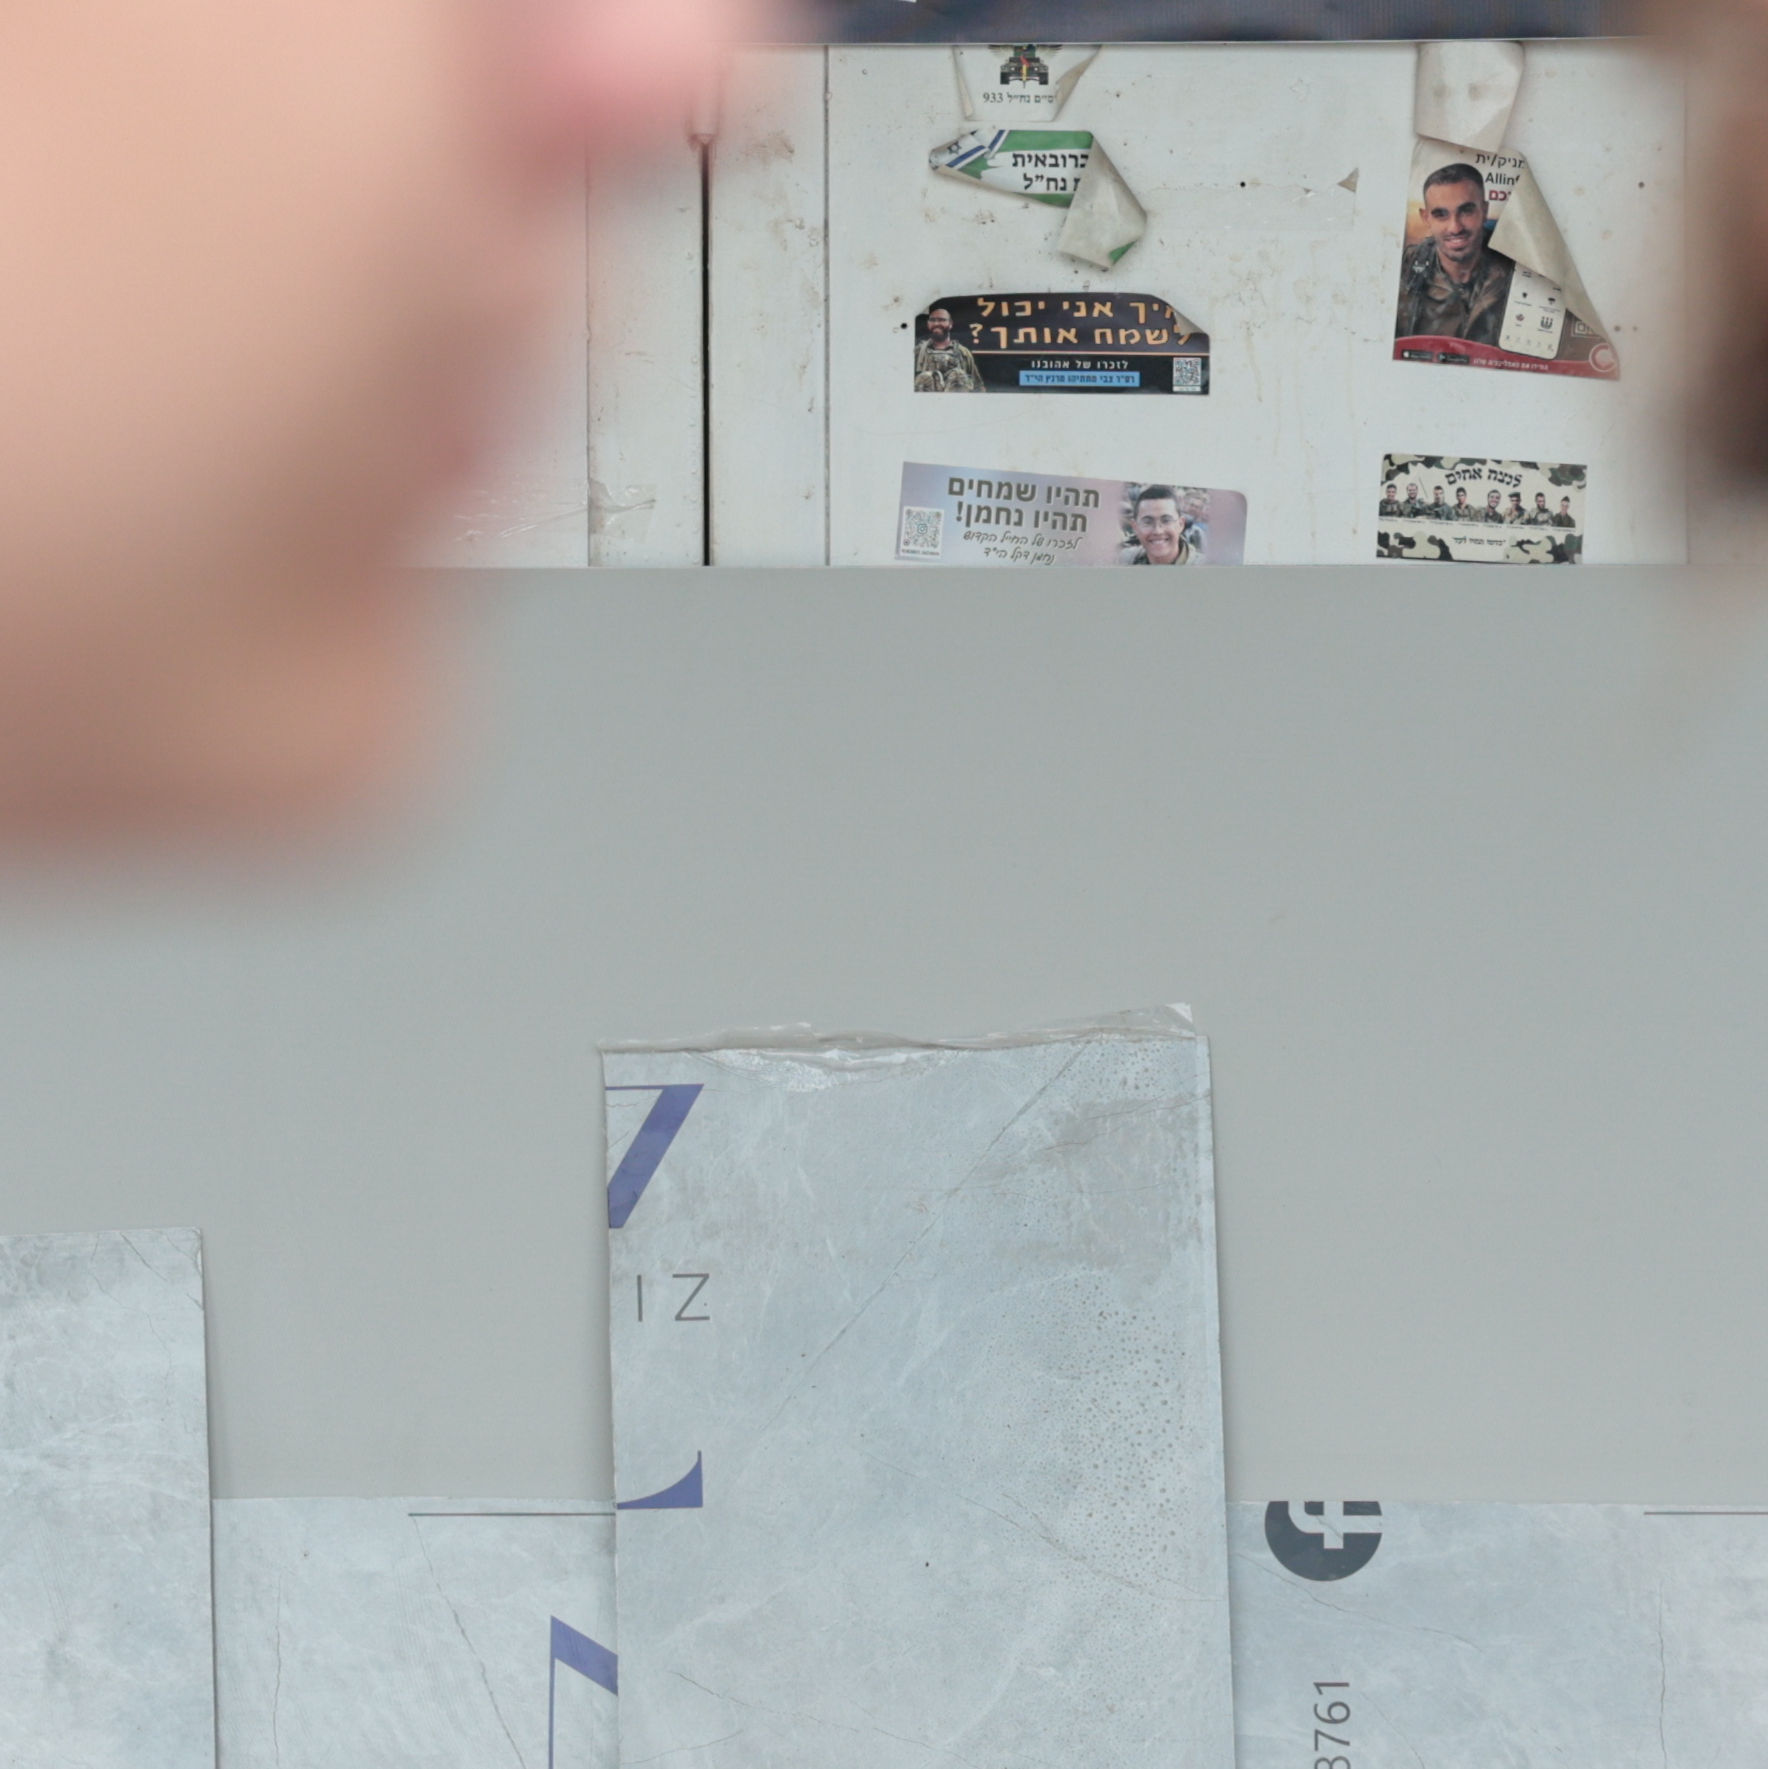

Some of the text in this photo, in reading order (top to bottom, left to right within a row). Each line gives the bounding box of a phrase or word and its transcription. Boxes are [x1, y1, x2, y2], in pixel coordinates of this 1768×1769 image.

[982, 92, 1004, 104] 933
[1023, 172, 1067, 192] נח"ל
[977, 297, 1045, 317] יכול
[1062, 301, 1114, 317] אני
[969, 323, 1079, 349] אותך?
[1031, 360, 1129, 369] לזכרו של אהובנו
[948, 477, 1100, 508] תהיו שמחים
[956, 500, 1088, 533] תהיו נחמן!
[963, 530, 1084, 550] לזכרו של החייל הקדוש
[984, 546, 1055, 566] נחמן דקל הי"ד
